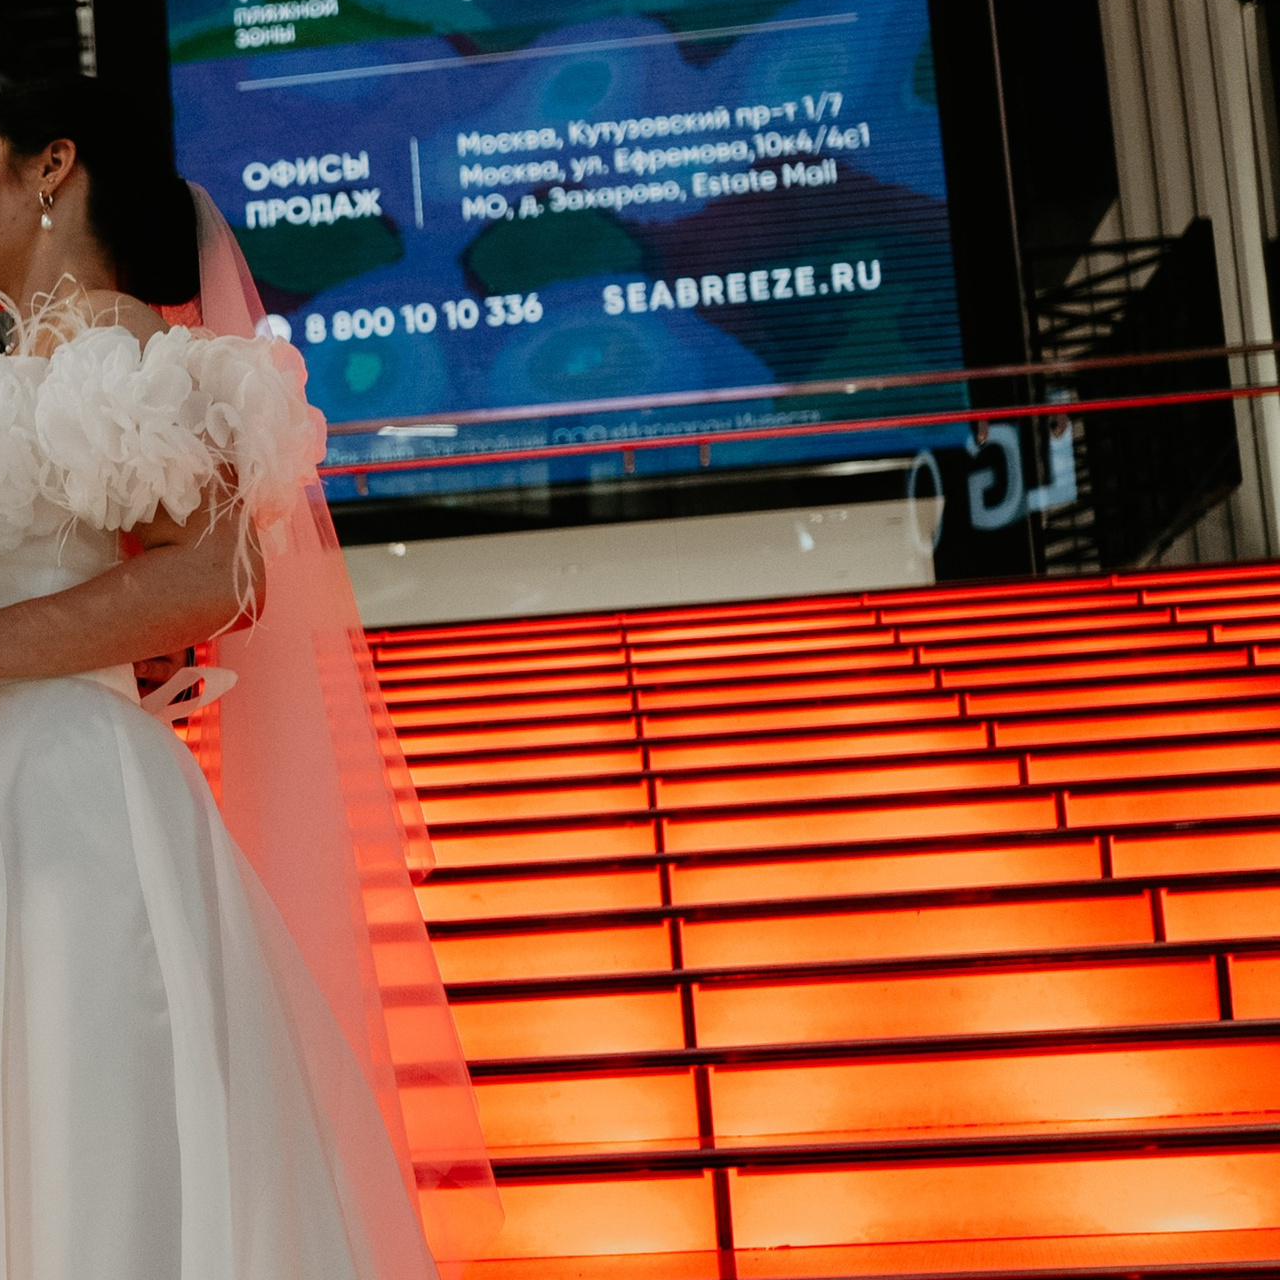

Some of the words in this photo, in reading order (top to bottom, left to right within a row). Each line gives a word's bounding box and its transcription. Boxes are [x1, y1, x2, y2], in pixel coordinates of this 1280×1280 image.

[234, 22, 296, 49] зоны
[457, 128, 564, 157] Москва,
[568, 106, 730, 148] Кутузовский
[801, 91, 844, 123] 1/7
[242, 150, 370, 191] ОФИСЫ
[459, 160, 566, 189] Москва,
[570, 154, 610, 183] ул.
[462, 192, 514, 221] МО,
[691, 168, 778, 199] Estate
[781, 157, 838, 190] Mall
[245, 187, 383, 230] ПРОДАЖ
[602, 259, 882, 316] SEABREEZE.RU
[305, 312, 327, 344] 8
[332, 306, 395, 342] 800
[400, 302, 437, 335] 10
[442, 298, 480, 331] 10
[484, 292, 544, 327] 336
